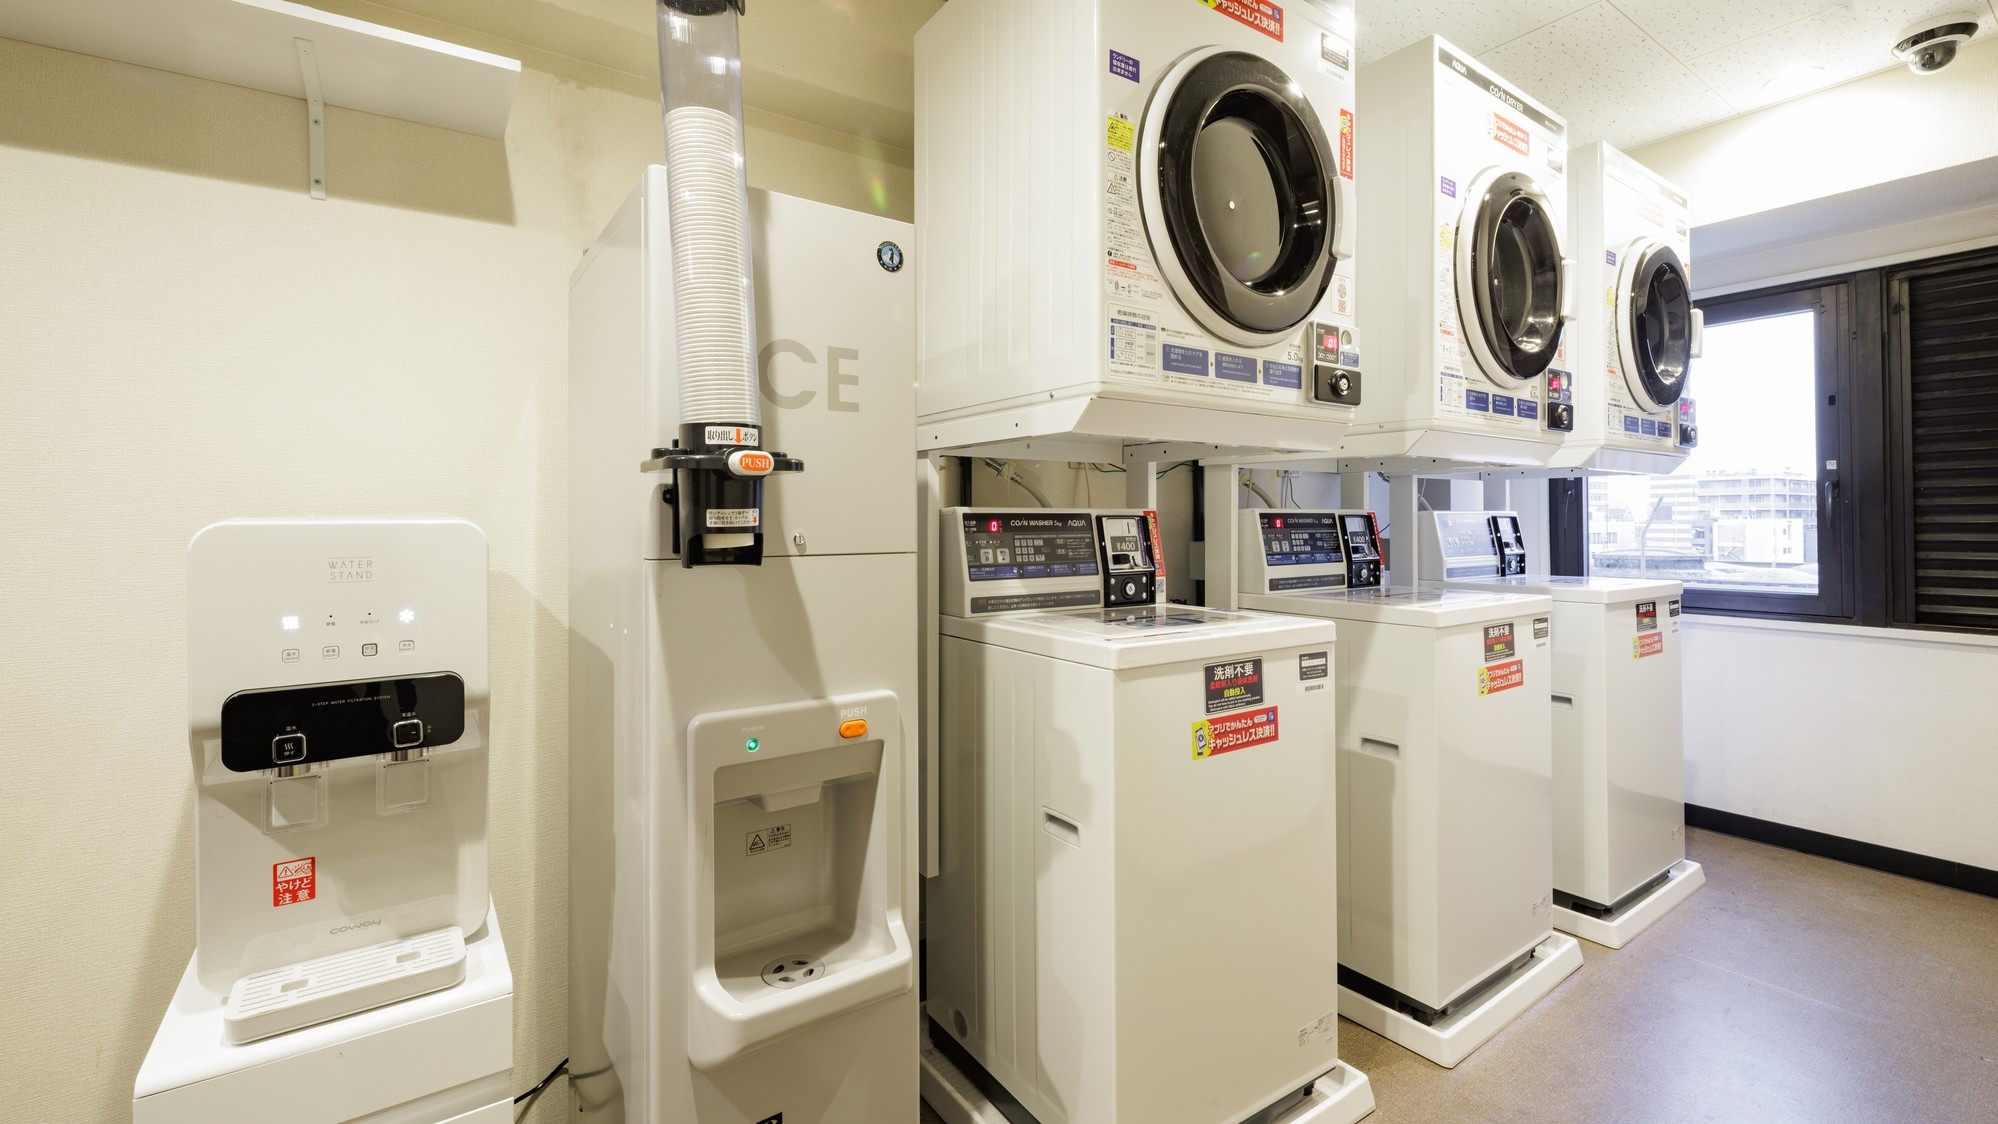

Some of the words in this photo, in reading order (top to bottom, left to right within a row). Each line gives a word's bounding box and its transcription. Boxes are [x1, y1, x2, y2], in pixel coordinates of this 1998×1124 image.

[758, 338, 860, 412] CE
[707, 430, 734, 442] 取り出し
[742, 431, 757, 442] ボタン
[742, 458, 770, 468] PUSH
[992, 521, 997, 531] 0
[1116, 542, 1135, 550] ¥400
[328, 560, 372, 570] WATER
[330, 570, 372, 580] STAND
[1214, 662, 1253, 680] 洗剤不要
[1224, 686, 1245, 697] 自動投入
[841, 706, 867, 718] PUSH
[741, 725, 765, 733] POWER
[1209, 718, 1252, 735] アプリでかんたん
[1208, 725, 1275, 749] キャッシュレス決済!!
[276, 876, 312, 892] やけど
[278, 889, 310, 905] 注意
[329, 919, 382, 935] coway
